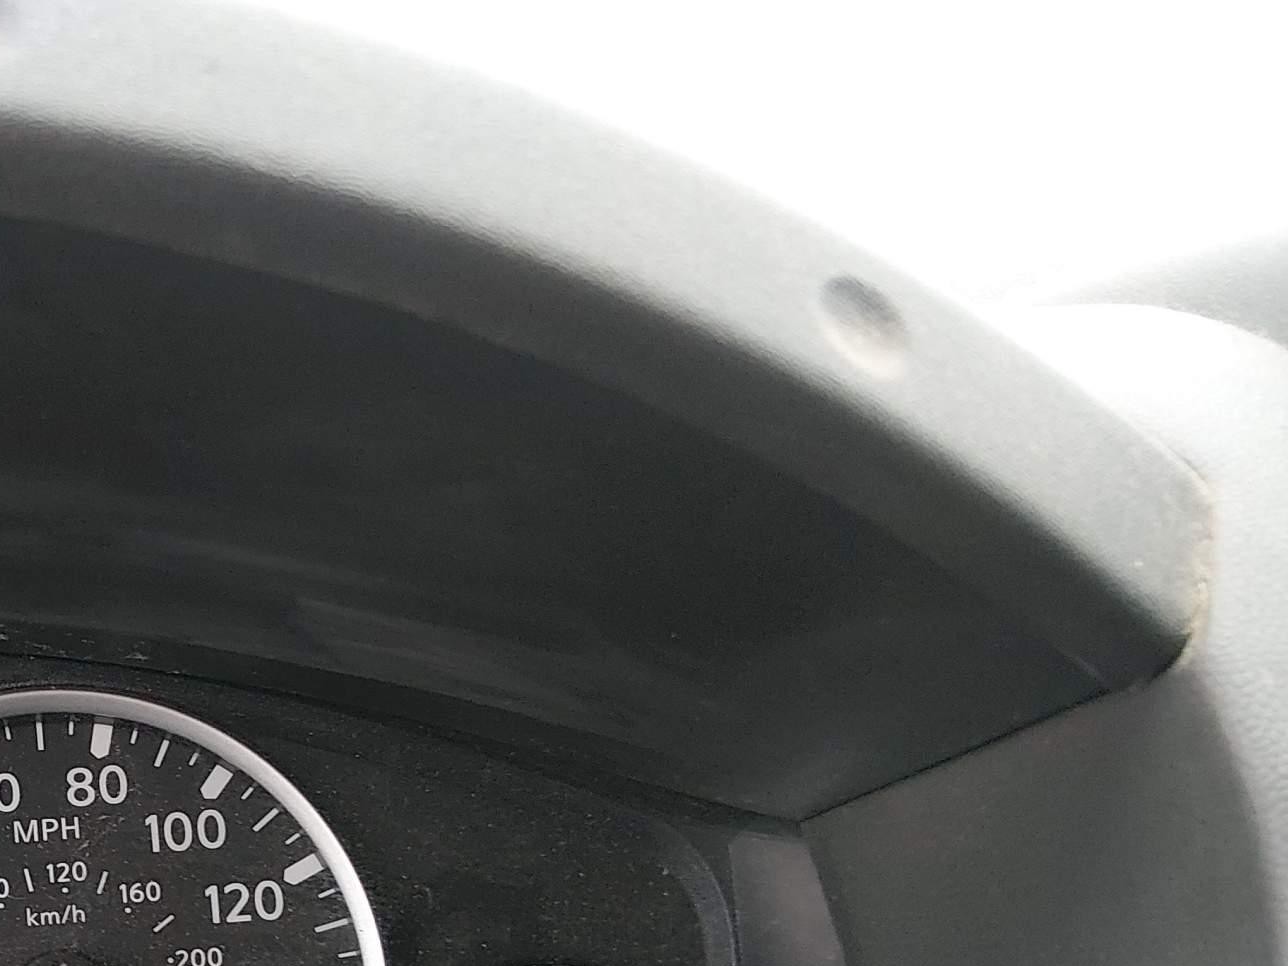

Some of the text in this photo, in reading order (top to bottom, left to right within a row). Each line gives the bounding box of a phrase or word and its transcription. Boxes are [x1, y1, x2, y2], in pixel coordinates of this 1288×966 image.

[66, 764, 128, 808] 80
[12, 816, 82, 844] MPH
[144, 810, 227, 853] 100
[45, 861, 88, 885] 120
[118, 880, 162, 904] 160
[204, 880, 284, 924] 120
[25, 903, 87, 929] km/h
